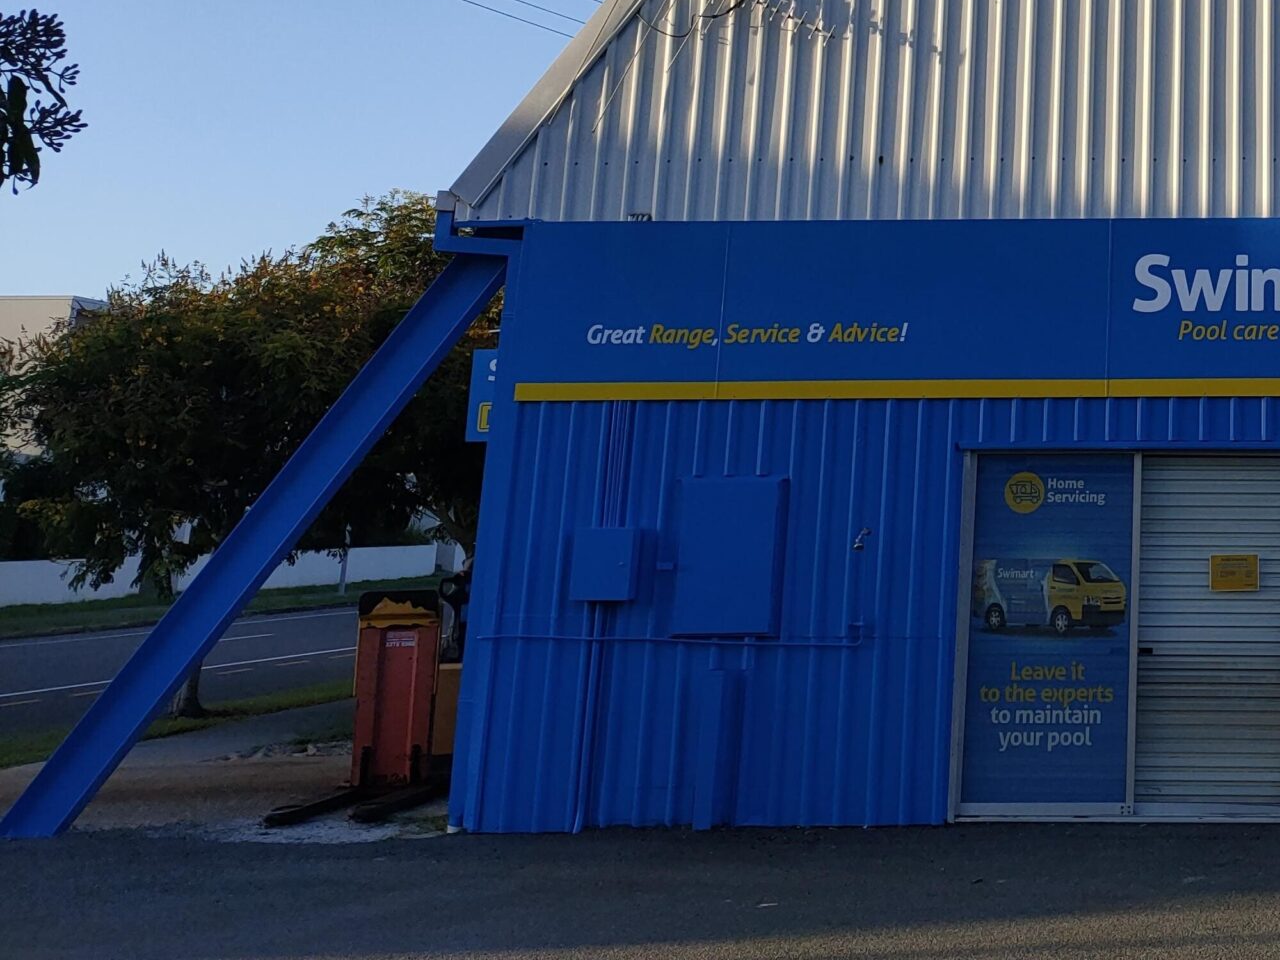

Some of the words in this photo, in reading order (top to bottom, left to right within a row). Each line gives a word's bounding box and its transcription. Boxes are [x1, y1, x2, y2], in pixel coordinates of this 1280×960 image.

[586, 324, 646, 345] Great
[649, 324, 718, 349] Range,
[724, 324, 800, 343] Service
[807, 323, 825, 342] &
[828, 323, 908, 342] Advice!
[1179, 320, 1227, 340] Pool
[1233, 325, 1279, 340] care
[1047, 477, 1085, 489] Home
[1047, 490, 1106, 505] Servicing
[998, 568, 1034, 579] Swimart
[1011, 662, 1066, 680] Leave
[1071, 661, 1085, 680] it
[980, 686, 1000, 702] to
[1005, 683, 1036, 702] the
[1040, 686, 1113, 707] experts
[991, 707, 1010, 723] to
[1016, 704, 1102, 724] maintain
[998, 732, 1044, 752] your
[1047, 727, 1092, 752] pool
